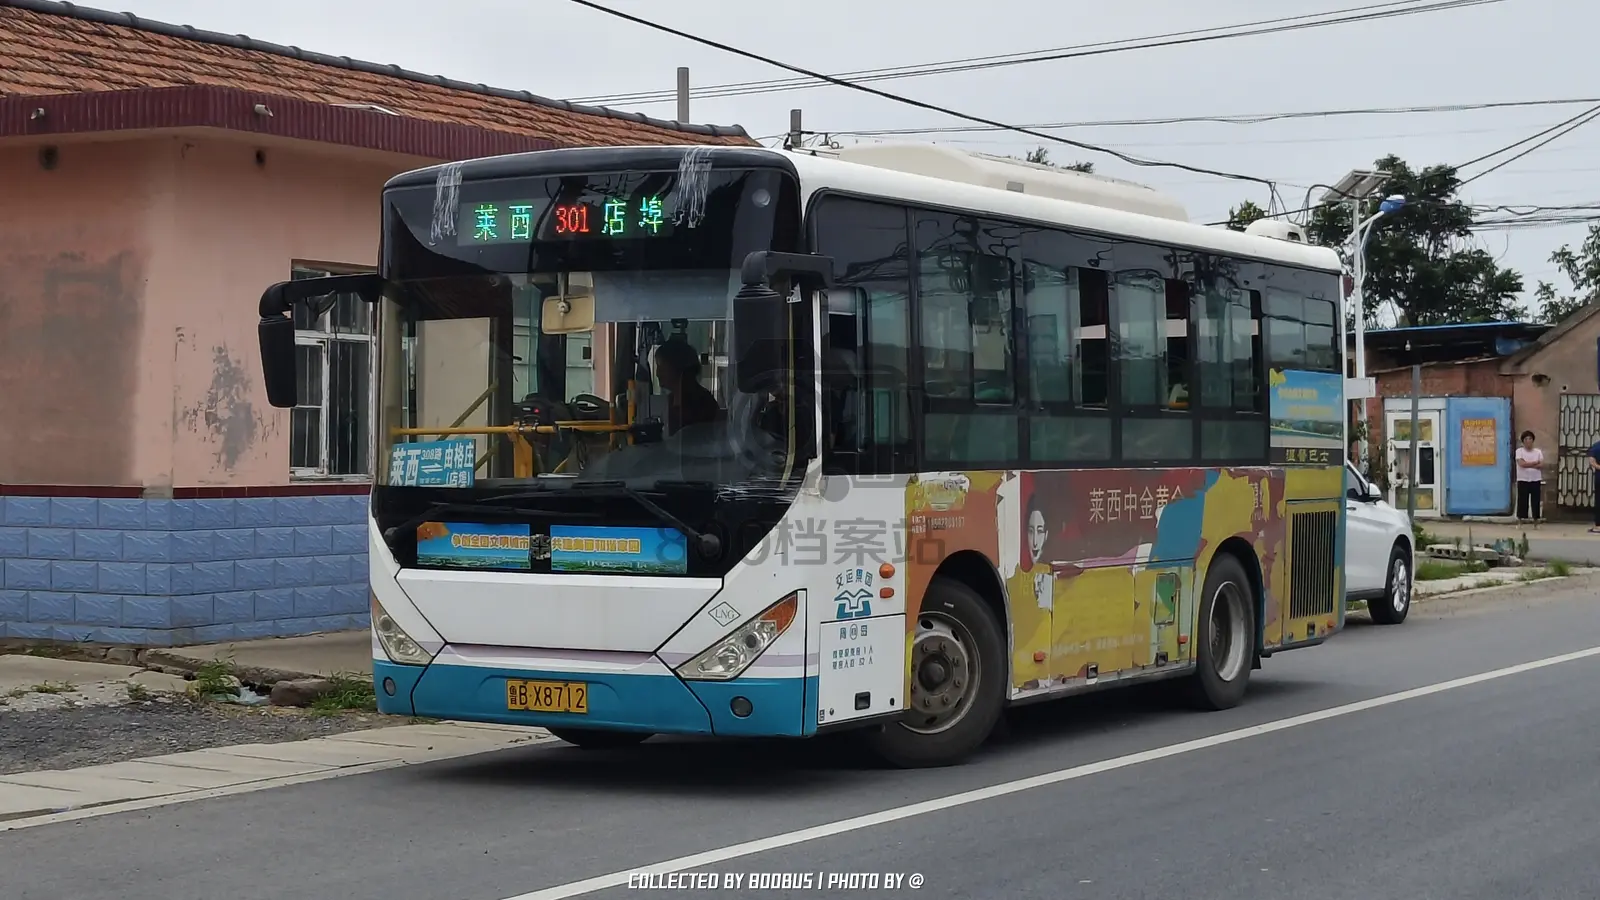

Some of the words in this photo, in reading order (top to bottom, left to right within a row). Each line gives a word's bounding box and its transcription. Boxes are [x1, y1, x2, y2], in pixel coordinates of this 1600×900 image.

[473, 204, 533, 240] 莱西
[556, 206, 590, 233] 301
[601, 197, 664, 236] 店埠
[389, 447, 421, 486] 莱西
[444, 442, 474, 469] 由格庄
[836, 568, 873, 589] 交运集团
[715, 609, 735, 620] LNG
